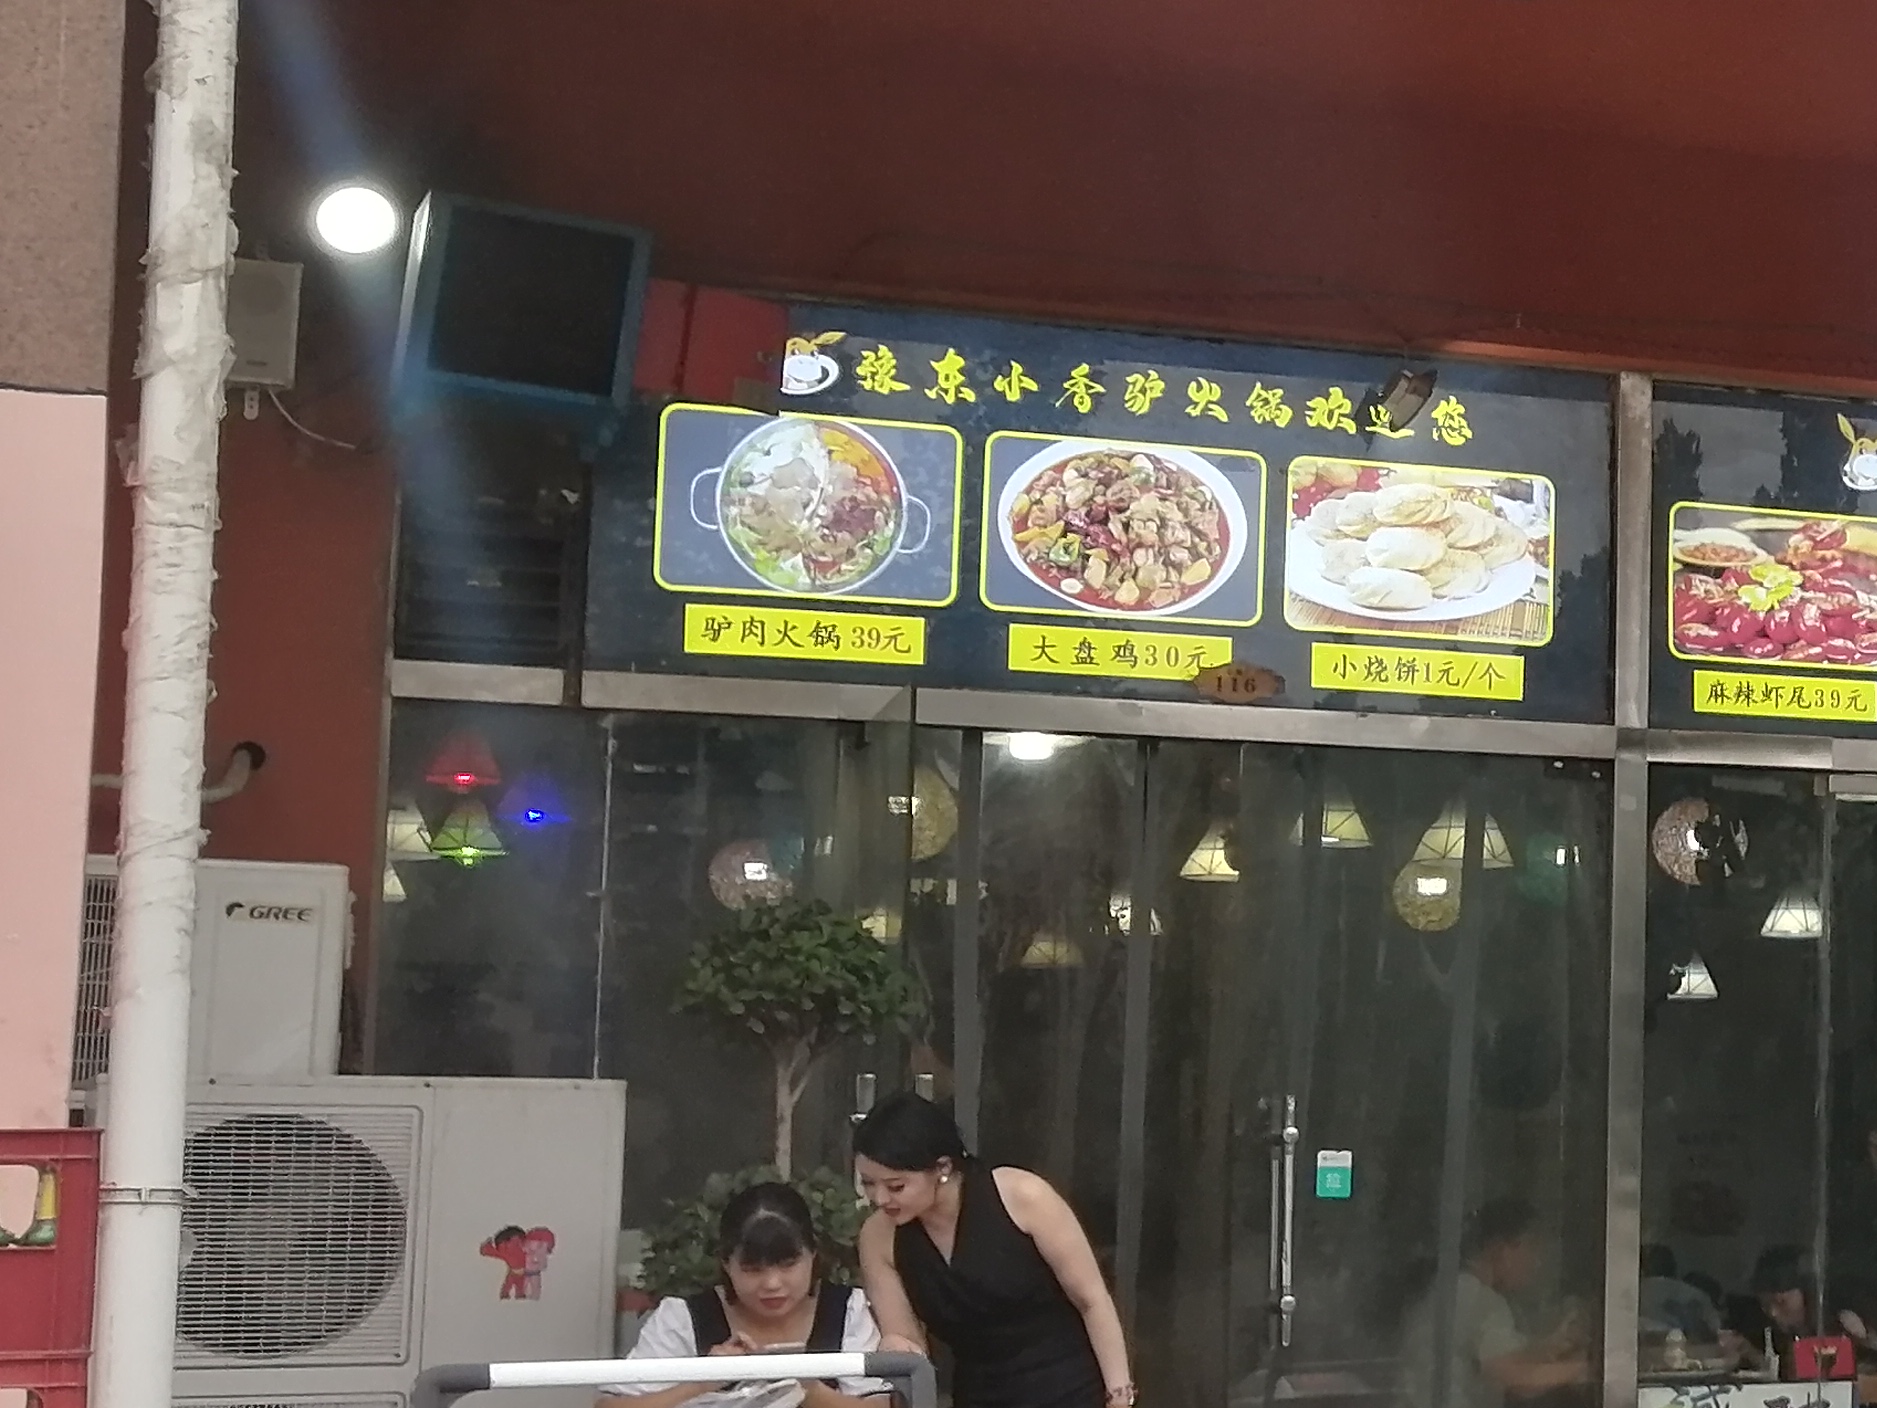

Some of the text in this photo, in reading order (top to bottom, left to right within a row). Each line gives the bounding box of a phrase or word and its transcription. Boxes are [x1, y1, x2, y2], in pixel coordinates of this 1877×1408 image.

[701, 615, 913, 655] 驴肉火锅39元
[1215, 675, 1257, 693] 116
[1332, 653, 1506, 691] 小烧饼1元/个
[1705, 680, 1869, 713] 麻辣虾尾39元
[248, 904, 314, 924] GREE
